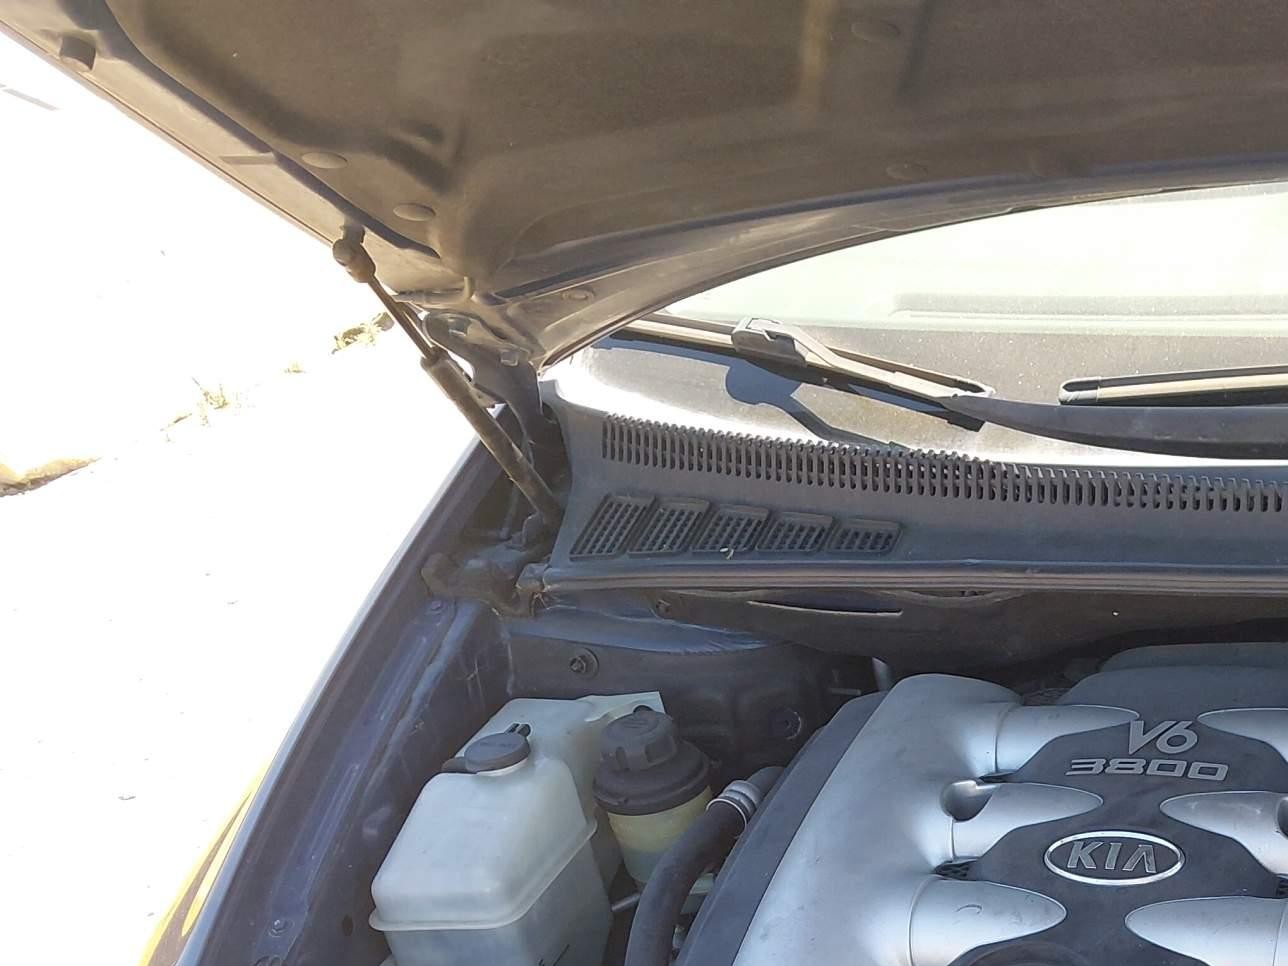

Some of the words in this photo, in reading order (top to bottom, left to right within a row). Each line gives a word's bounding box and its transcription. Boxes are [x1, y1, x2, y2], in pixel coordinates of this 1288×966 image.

[1128, 719, 1198, 755] V6
[1065, 757, 1230, 781] 3800
[1066, 841, 1158, 874] KIA
